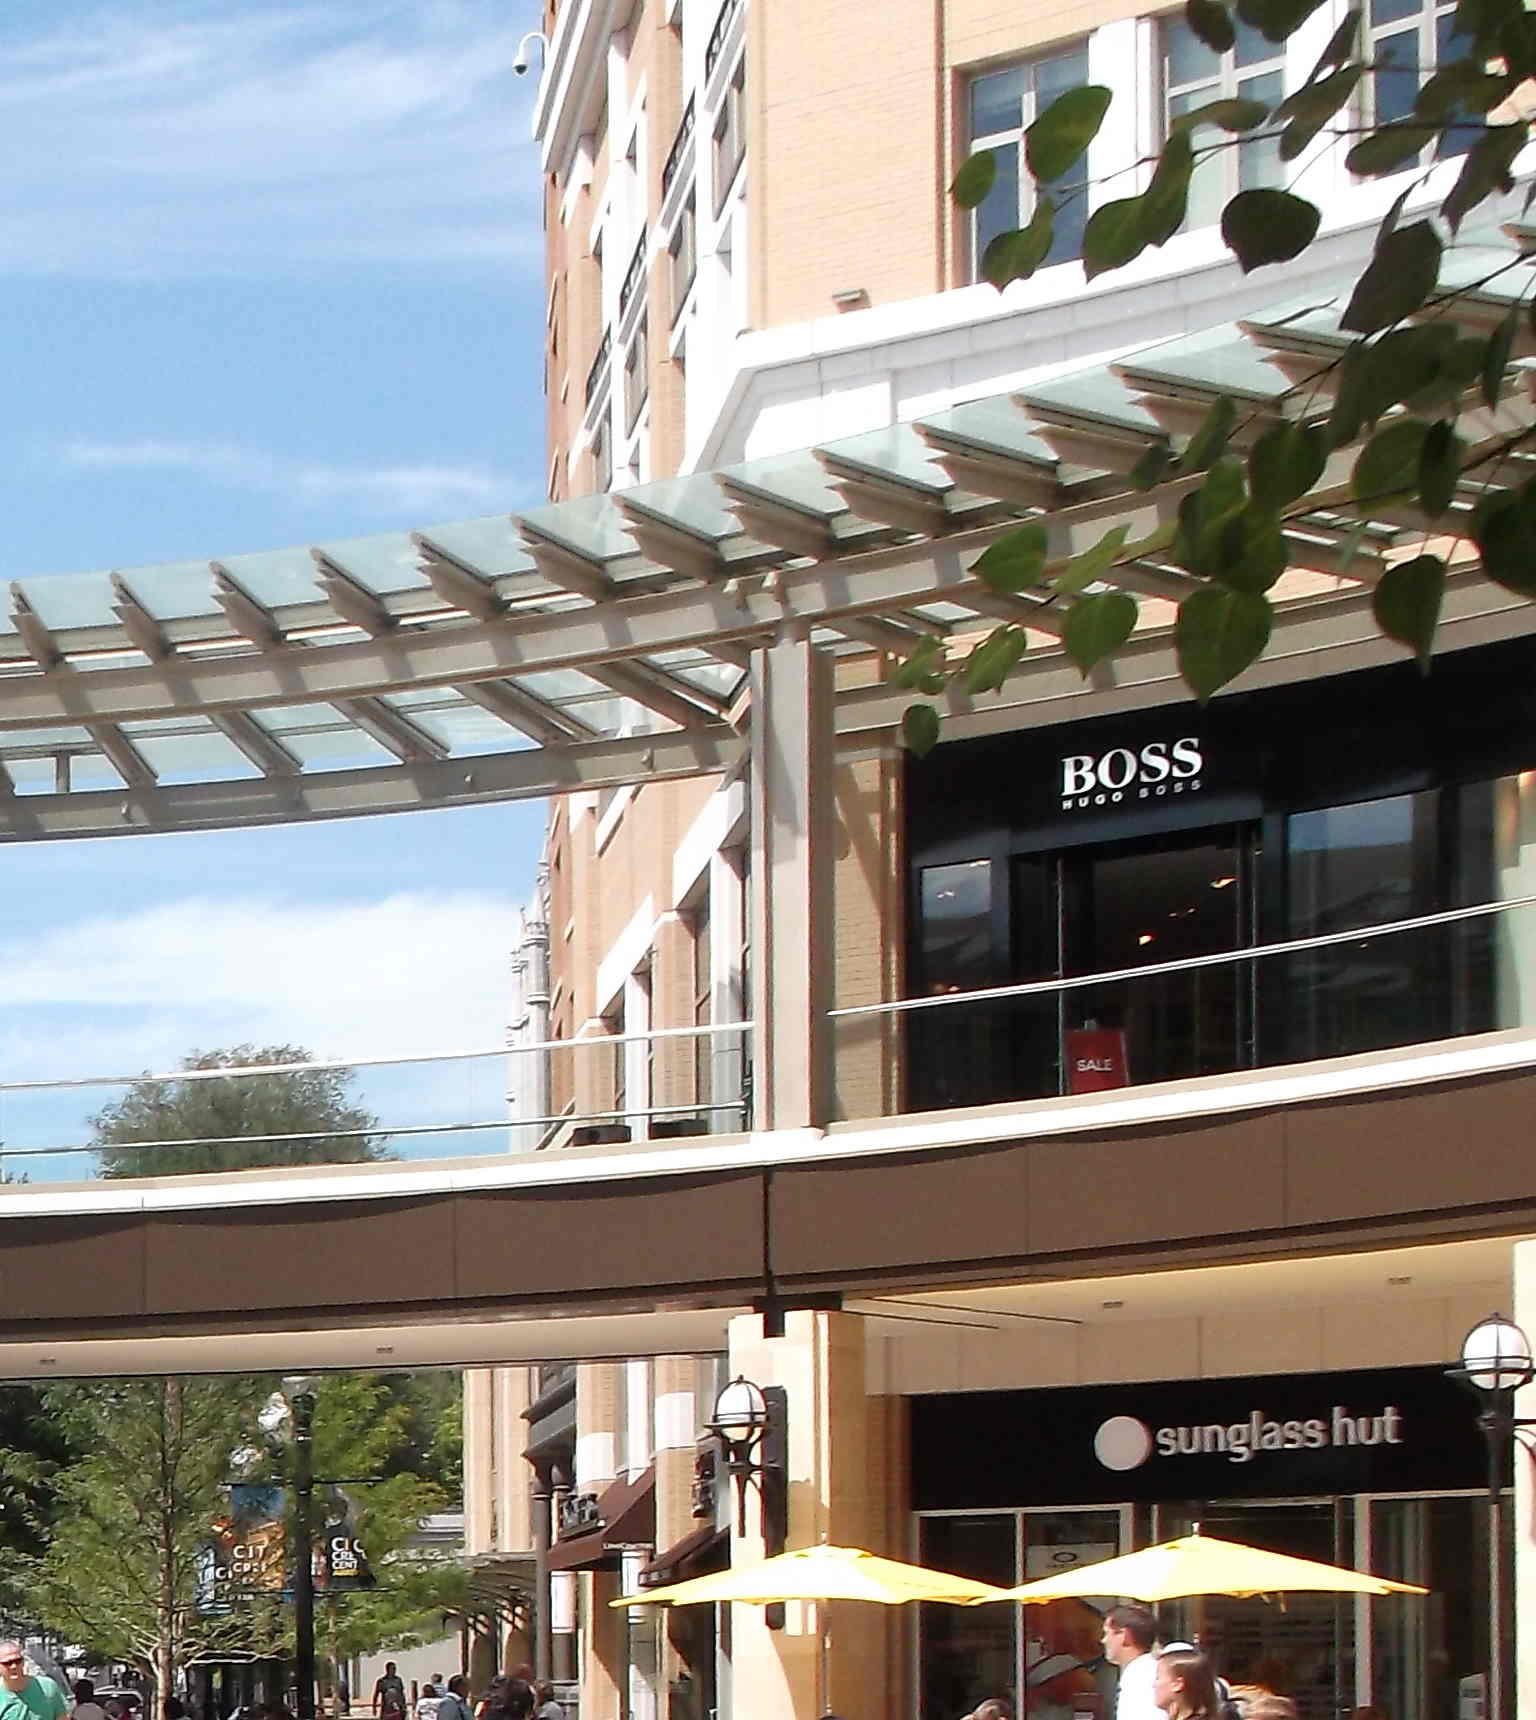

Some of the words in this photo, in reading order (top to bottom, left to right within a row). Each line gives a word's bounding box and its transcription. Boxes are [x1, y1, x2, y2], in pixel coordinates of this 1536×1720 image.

[1061, 737, 1203, 796] BOSS
[1062, 791, 1123, 810] HUGO
[1139, 780, 1201, 798] BOSS
[1077, 1058, 1112, 1072] SALE
[1156, 1411, 1328, 1462] sunglass
[1332, 1406, 1404, 1446] hut
